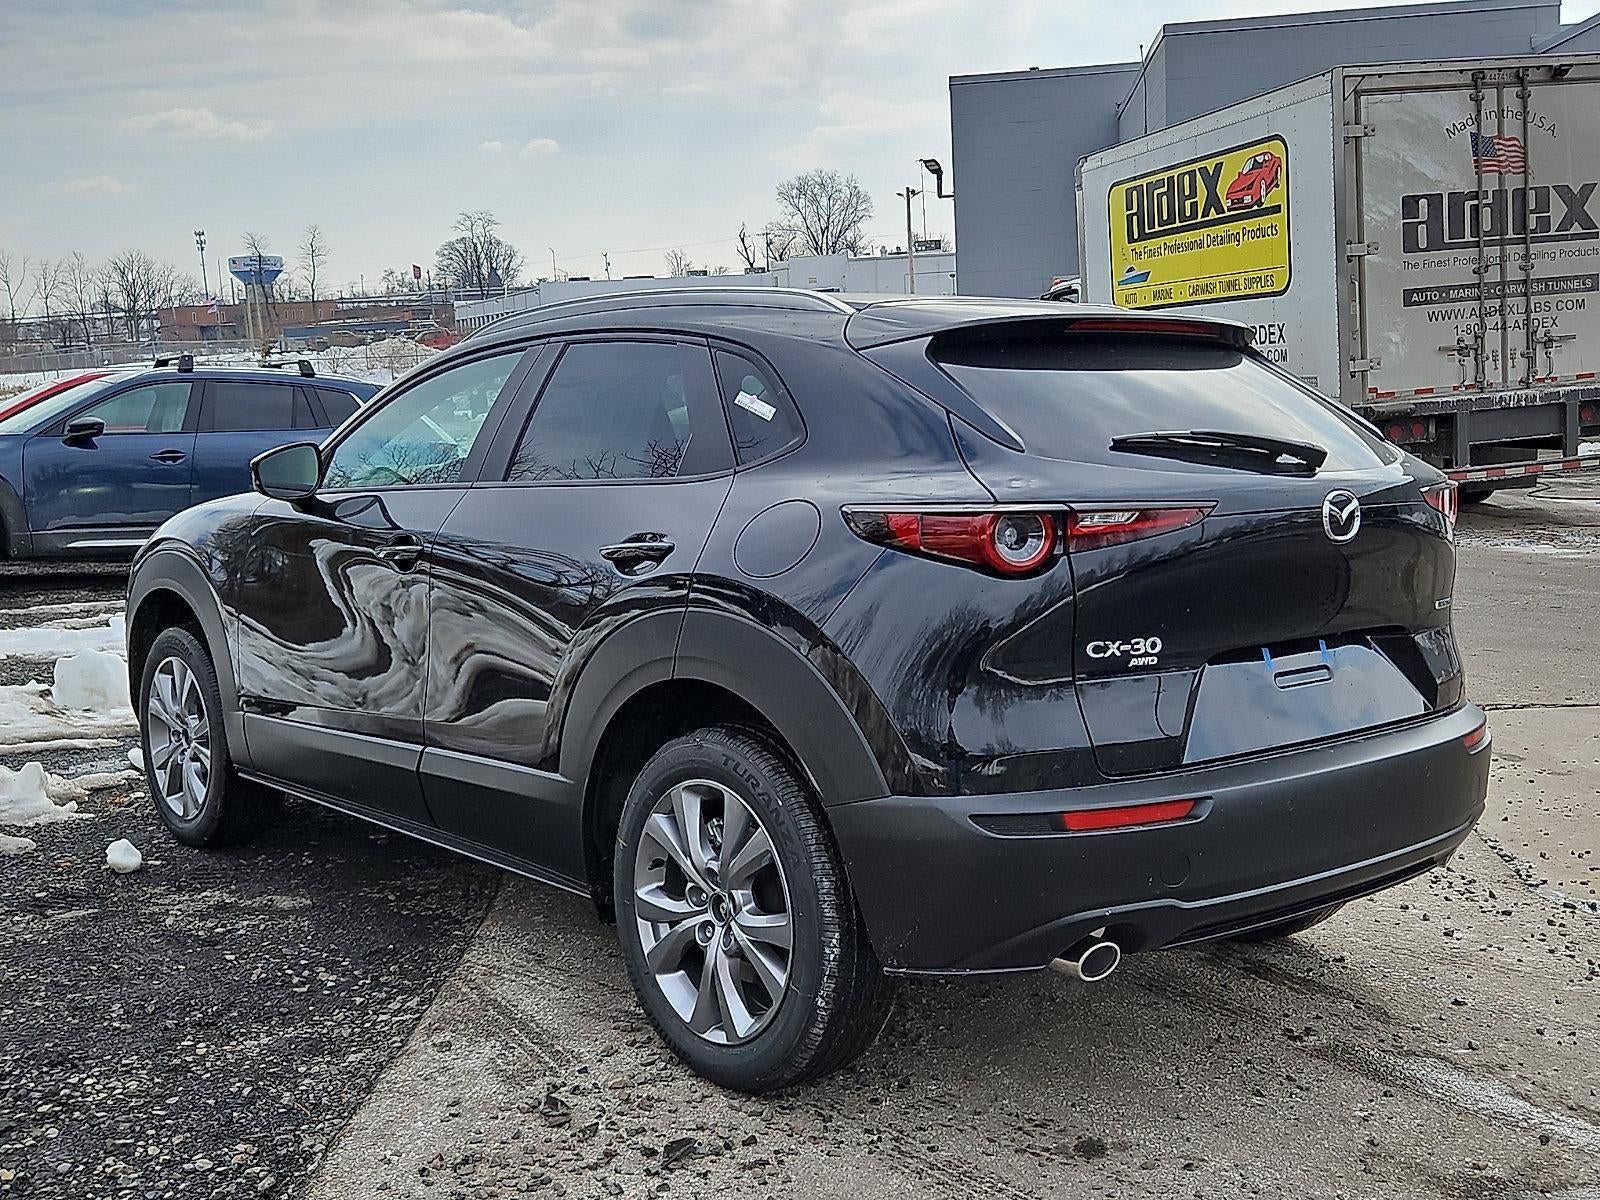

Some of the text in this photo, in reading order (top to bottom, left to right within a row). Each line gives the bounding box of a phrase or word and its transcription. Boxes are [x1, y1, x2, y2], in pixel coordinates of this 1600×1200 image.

[1484, 108, 1498, 120] in
[1501, 106, 1523, 120] the
[1131, 222, 1278, 261] The Finest Professional Detailing Products
[1402, 260, 1420, 271] The
[1422, 257, 1450, 269] Finest
[1513, 249, 1556, 261] Deailing
[1559, 246, 1599, 258] Products
[1124, 273, 1274, 305] AUTO MARINE CARWASH TUNNEL SUPPLIES
[1411, 278, 1592, 303] AUTO MARINE CARWSH TUNNELS
[1086, 637, 1163, 658] CX-30
[1128, 656, 1159, 667] AWD
